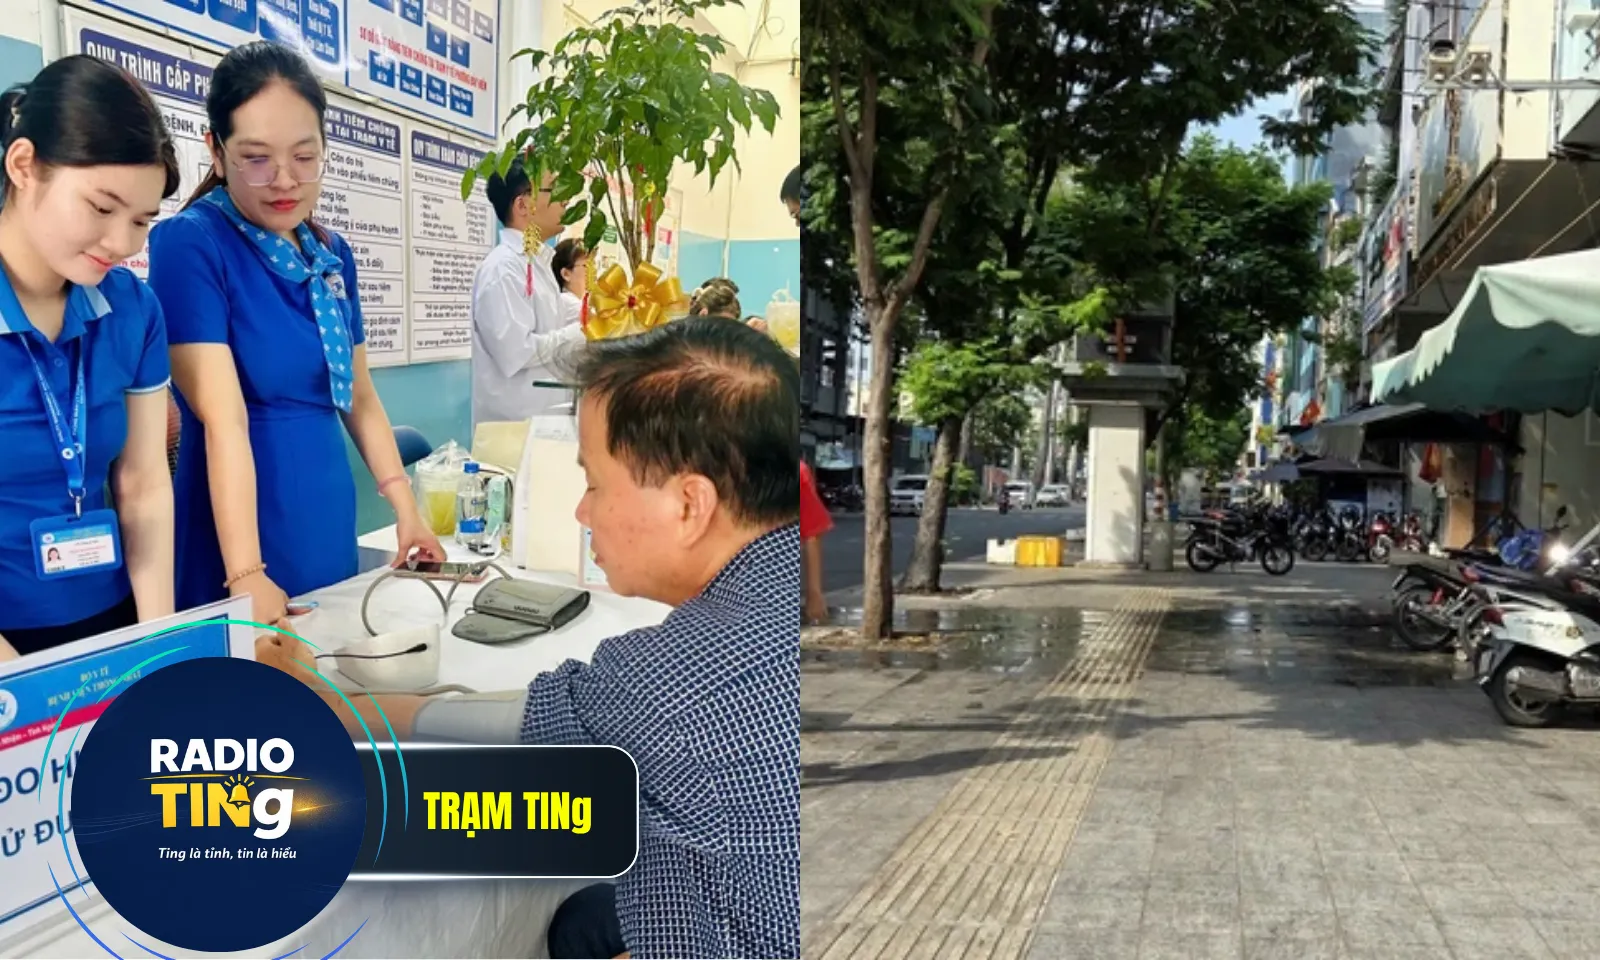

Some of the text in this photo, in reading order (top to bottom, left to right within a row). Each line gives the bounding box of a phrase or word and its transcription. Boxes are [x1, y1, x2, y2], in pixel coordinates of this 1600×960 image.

[120, 51, 162, 85] TRÌNH
[166, 60, 191, 92] CẤP
[194, 73, 211, 97] PH
[343, 112, 366, 129] TIÊM
[51, 750, 80, 784] H
